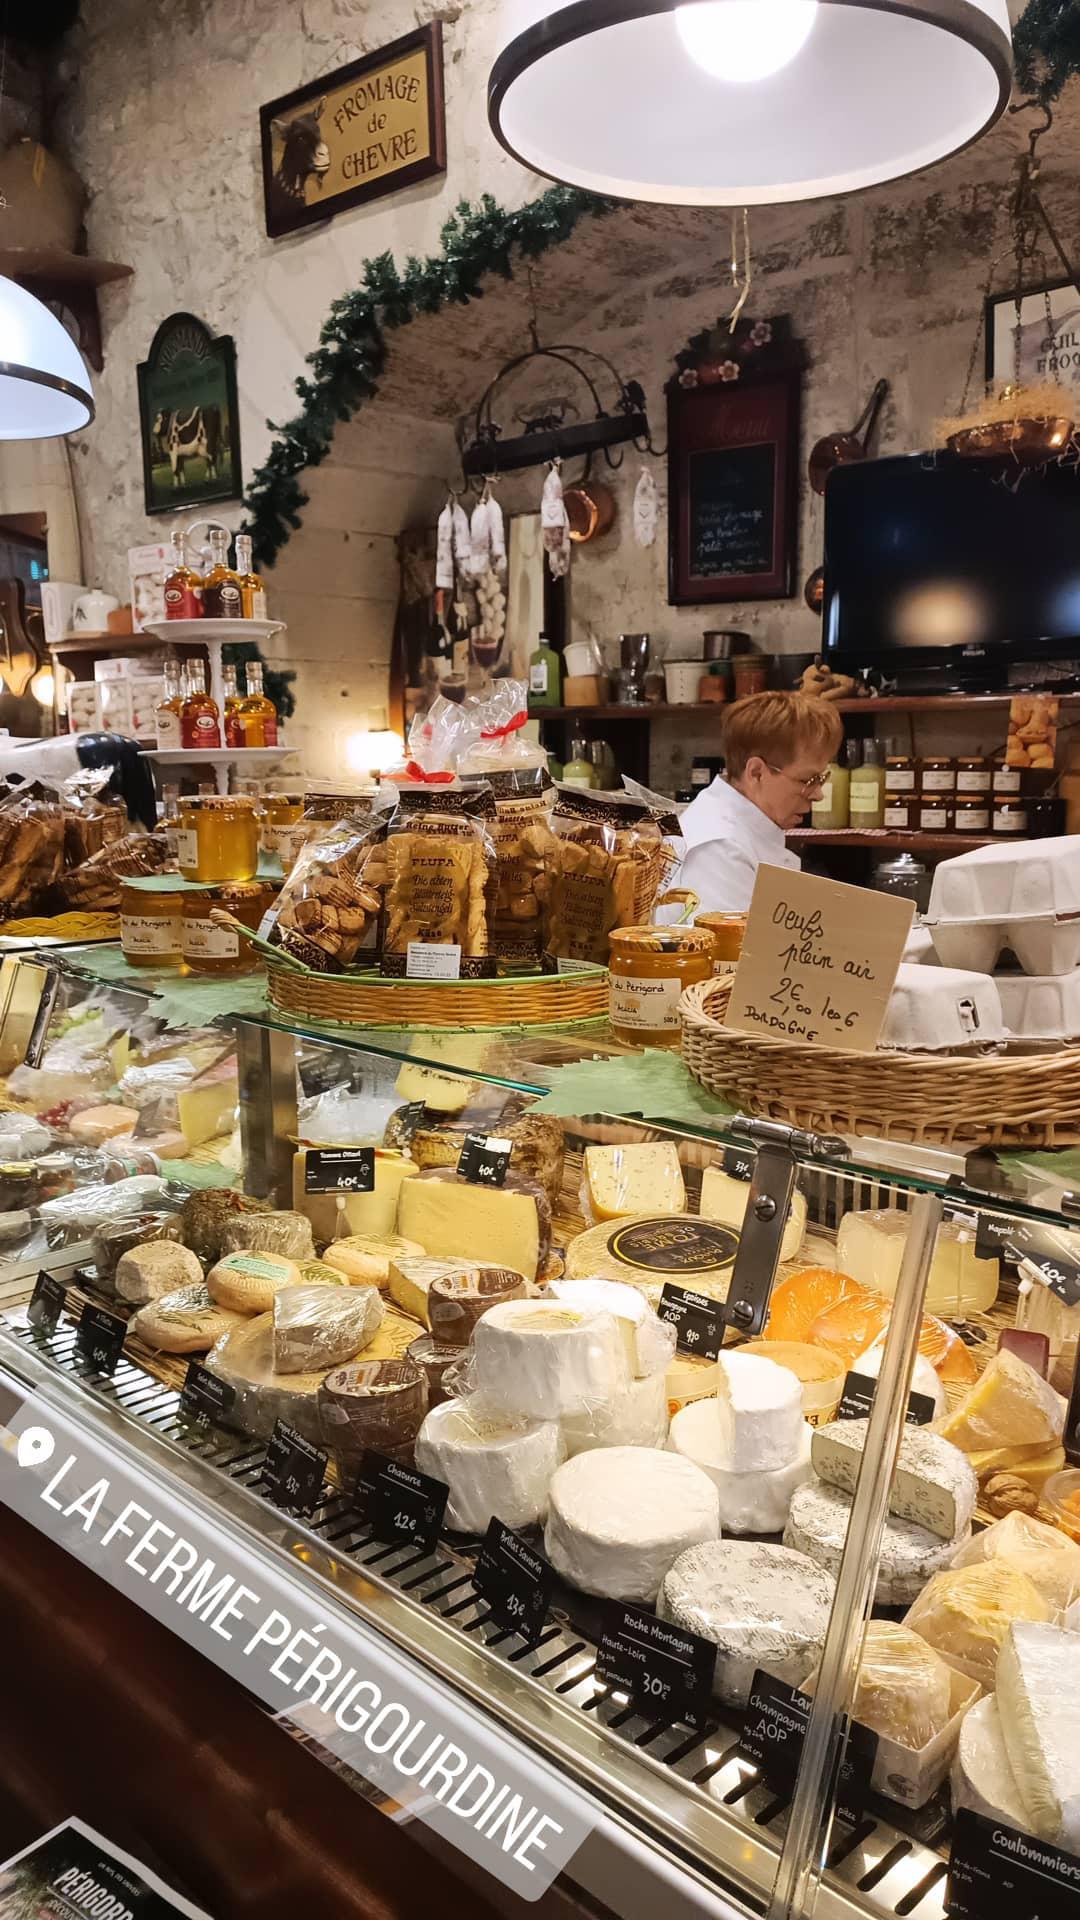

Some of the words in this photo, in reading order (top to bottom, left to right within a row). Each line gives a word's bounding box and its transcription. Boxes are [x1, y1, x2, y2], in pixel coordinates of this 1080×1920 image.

[333, 74, 421, 135] FROMAGE
[367, 112, 387, 133] de
[341, 128, 418, 180] CHEVRE
[772, 901, 824, 941] Oeufs
[778, 940, 834, 973] plein
[843, 959, 876, 980] air
[615, 982, 623, 991] du
[744, 1004, 820, 1042] DORDOGNE
[844, 1011, 860, 1027] 6
[337, 1175, 359, 1187] 40€
[479, 1163, 495, 1176] 40€
[1040, 1261, 1067, 1283] 40€
[663, 1310, 681, 1323] AOP
[387, 1462, 422, 1488] Chaource
[393, 1511, 417, 1530] 12€
[501, 1529, 519, 1554] Brillat
[518, 1546, 543, 1576] Savarin
[506, 1593, 526, 1616] 13€
[624, 1612, 649, 1635] Roche
[650, 1625, 695, 1655] Montagne
[602, 1633, 647, 1663] Haute-Loire
[750, 1694, 807, 1735] Champagne
[756, 1718, 788, 1743] AOP
[991, 1829, 1080, 1881] Coulommiers
